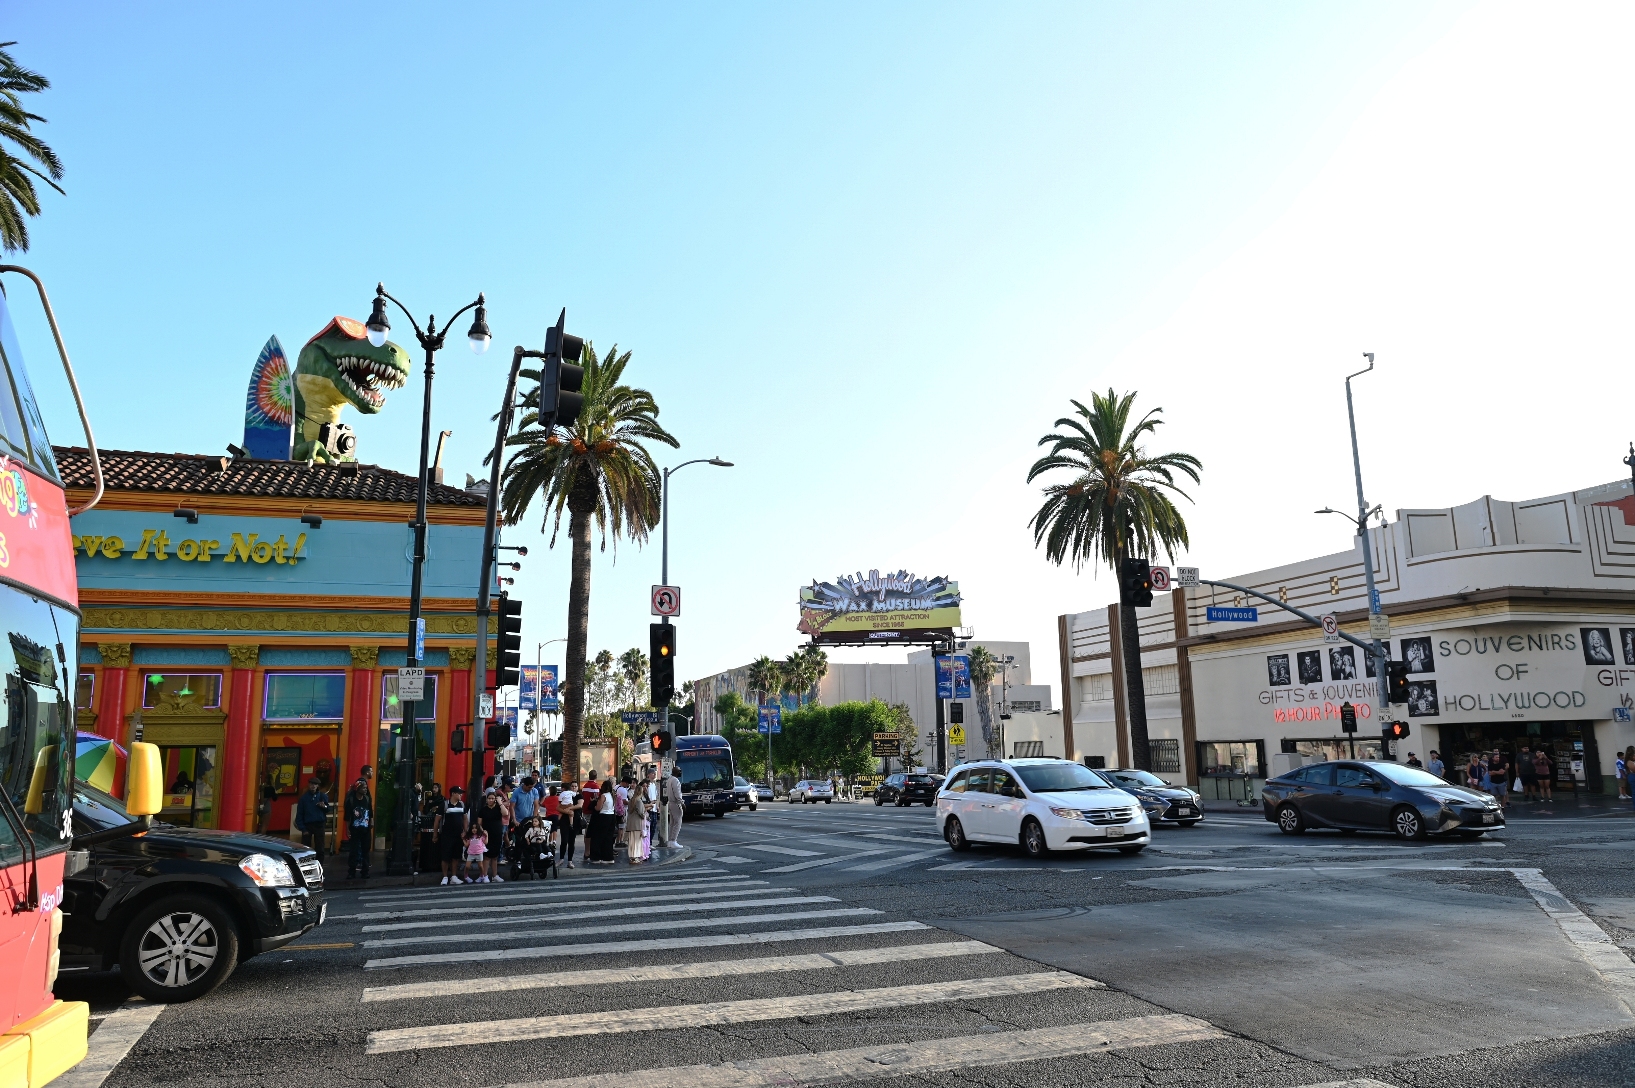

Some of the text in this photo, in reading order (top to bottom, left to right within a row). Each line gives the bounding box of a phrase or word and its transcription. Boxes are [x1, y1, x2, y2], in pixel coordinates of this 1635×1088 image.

[132, 529, 171, 562] It
[176, 538, 220, 563] or
[223, 532, 308, 567] Not!
[847, 568, 916, 602] Hollywood
[889, 613, 930, 621] ATTRACTION
[1211, 610, 1253, 620] Hollywood
[1439, 633, 1576, 657] SOUVENIRS
[1495, 663, 1529, 681] OF
[1259, 682, 1380, 705] GIFTS & SOUVENI
[1443, 691, 1586, 712] HOLLYWOOD
[1286, 706, 1321, 722] HOUR
[1324, 701, 1371, 720] PHTO
